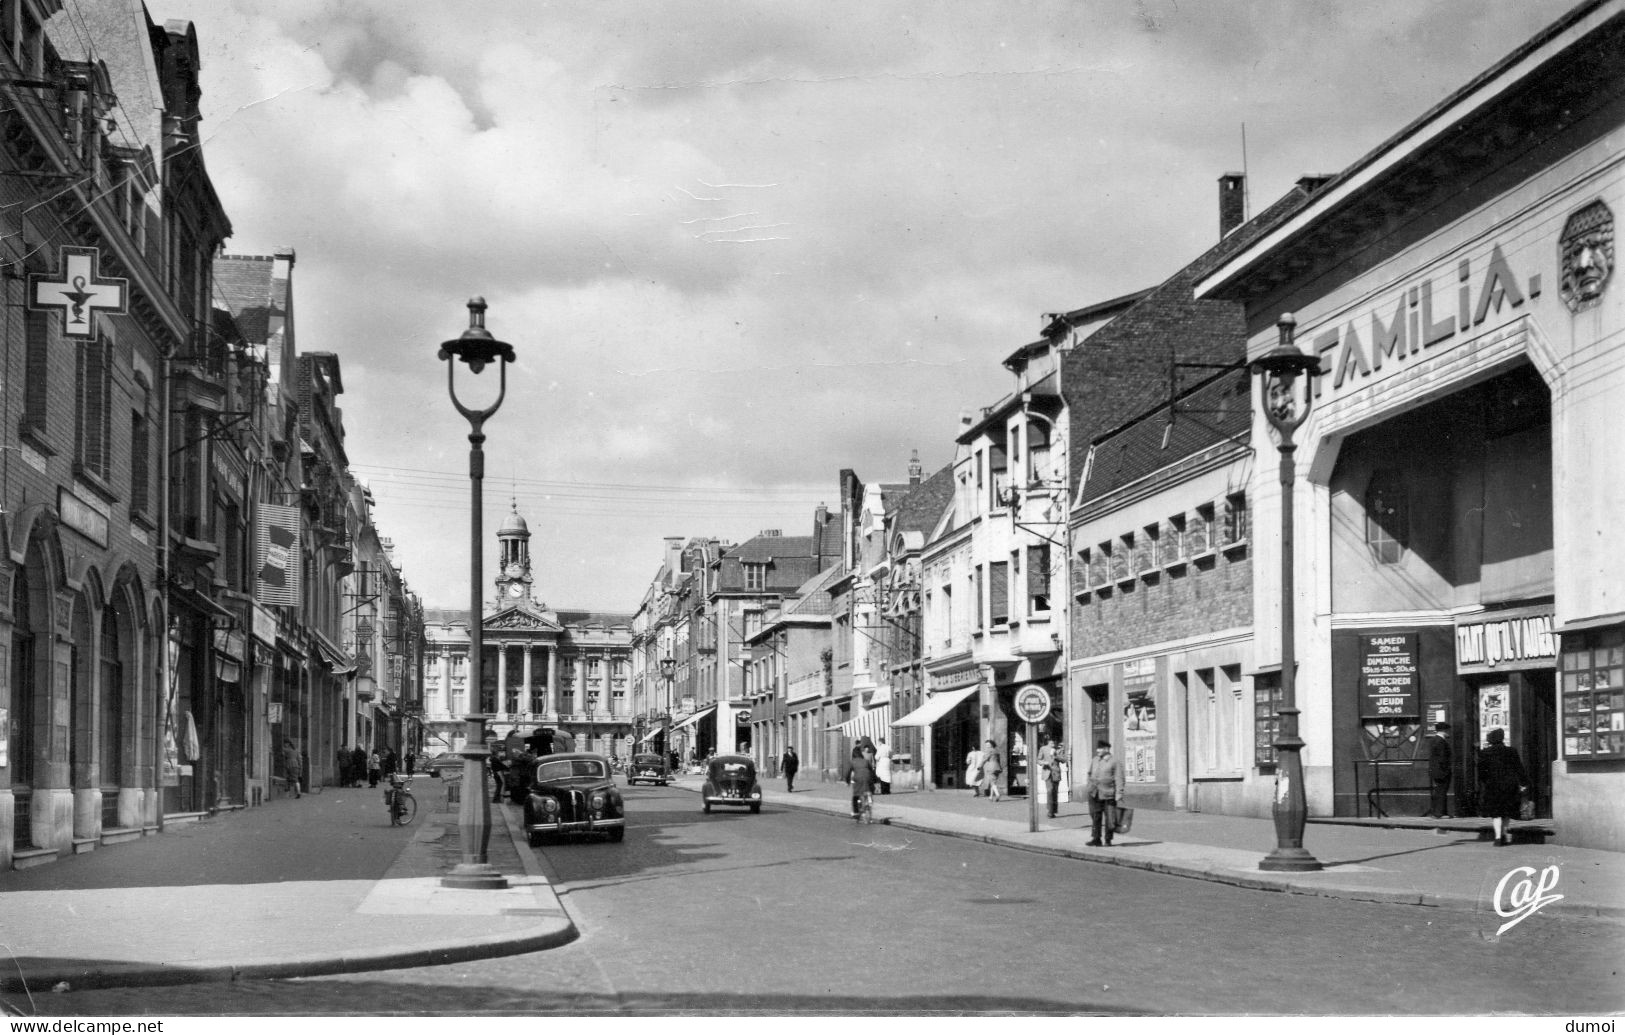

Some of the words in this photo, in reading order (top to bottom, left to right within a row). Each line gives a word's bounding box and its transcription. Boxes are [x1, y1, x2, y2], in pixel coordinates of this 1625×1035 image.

[1370, 636, 1406, 646] SAMEDI
[1458, 623, 1484, 665] TANT
[1511, 618, 1522, 660] Y
[1522, 614, 1556, 659] AURA
[1366, 656, 1411, 666] DIMANCHE
[1367, 677, 1411, 686] MERCREDI
[1375, 697, 1404, 706] JEUDI
